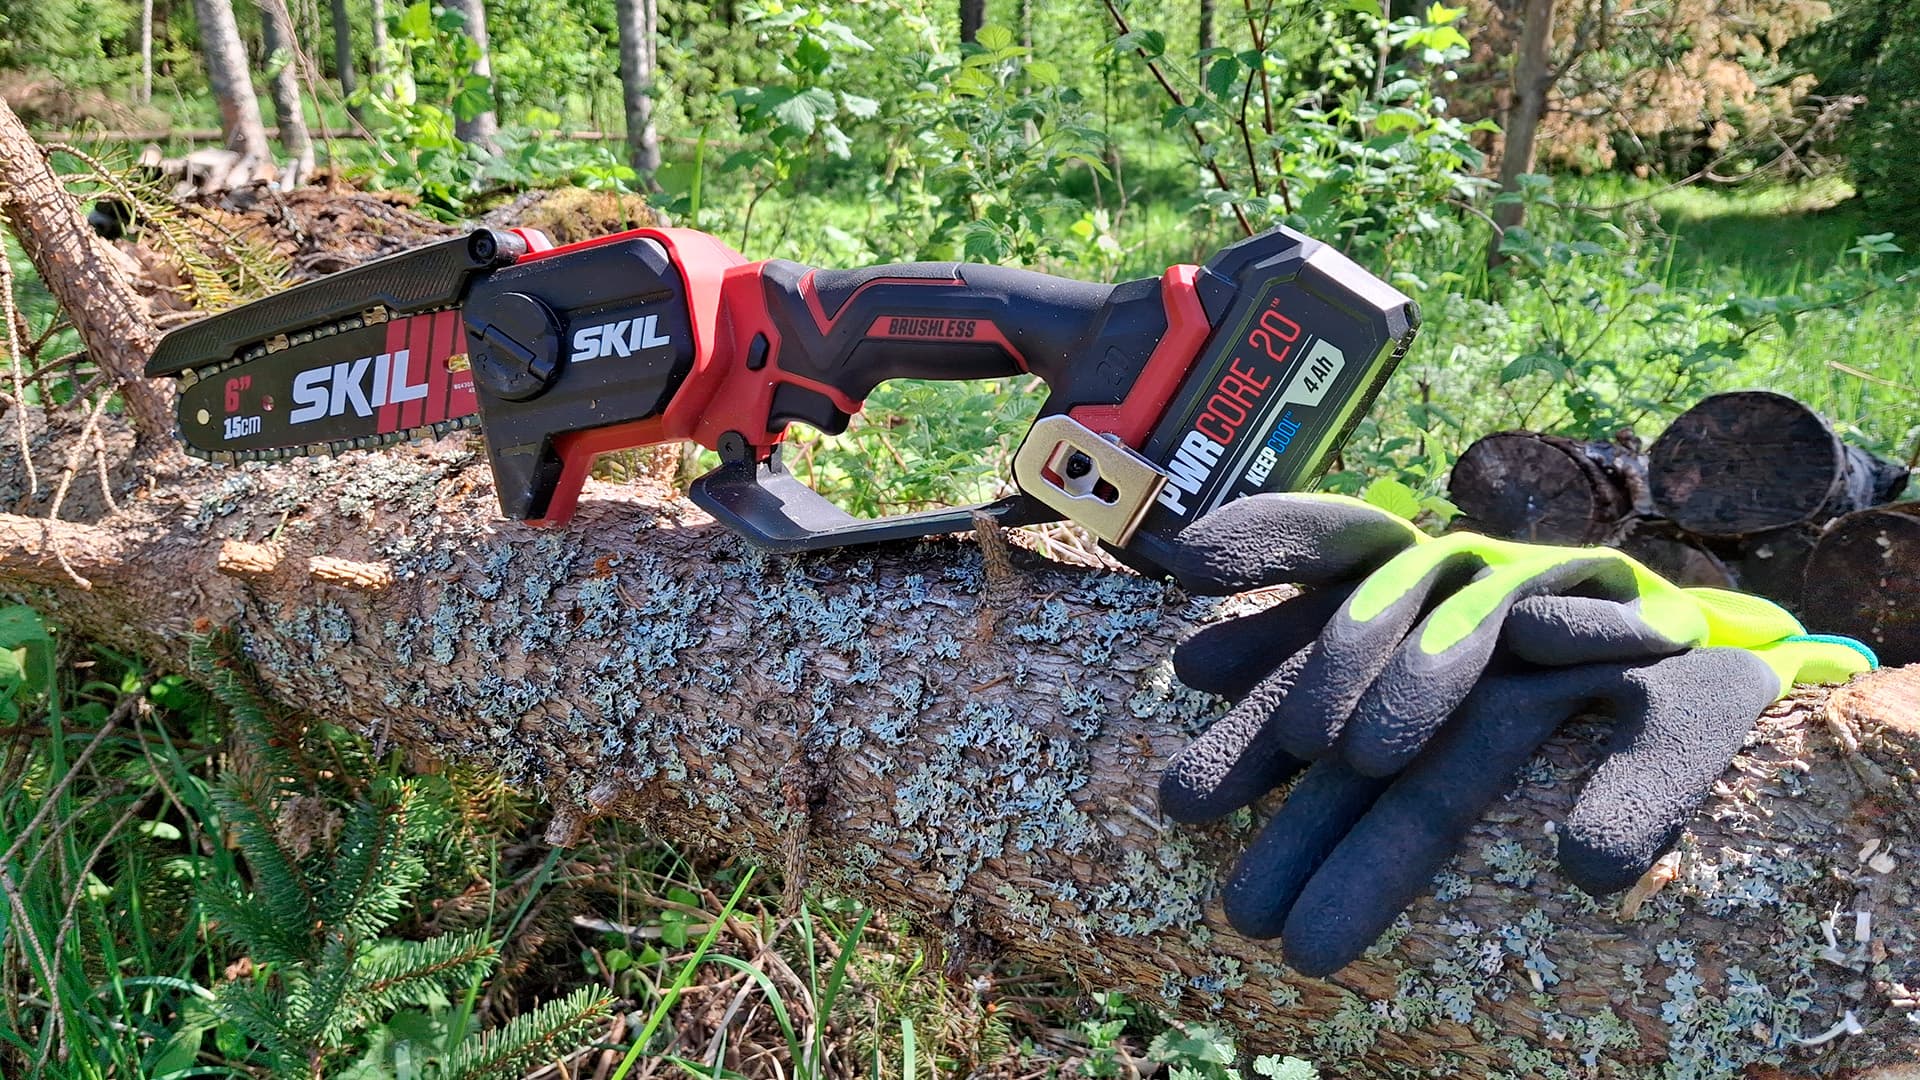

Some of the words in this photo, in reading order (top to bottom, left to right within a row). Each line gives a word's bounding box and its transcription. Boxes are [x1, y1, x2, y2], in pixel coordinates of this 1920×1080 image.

[571, 314, 670, 362] SKIL
[888, 318, 977, 338] BRUSHLESS
[289, 349, 429, 425] SKIL
[223, 415, 262, 440] 15cm
[1157, 357, 1271, 516] PWRCORE
